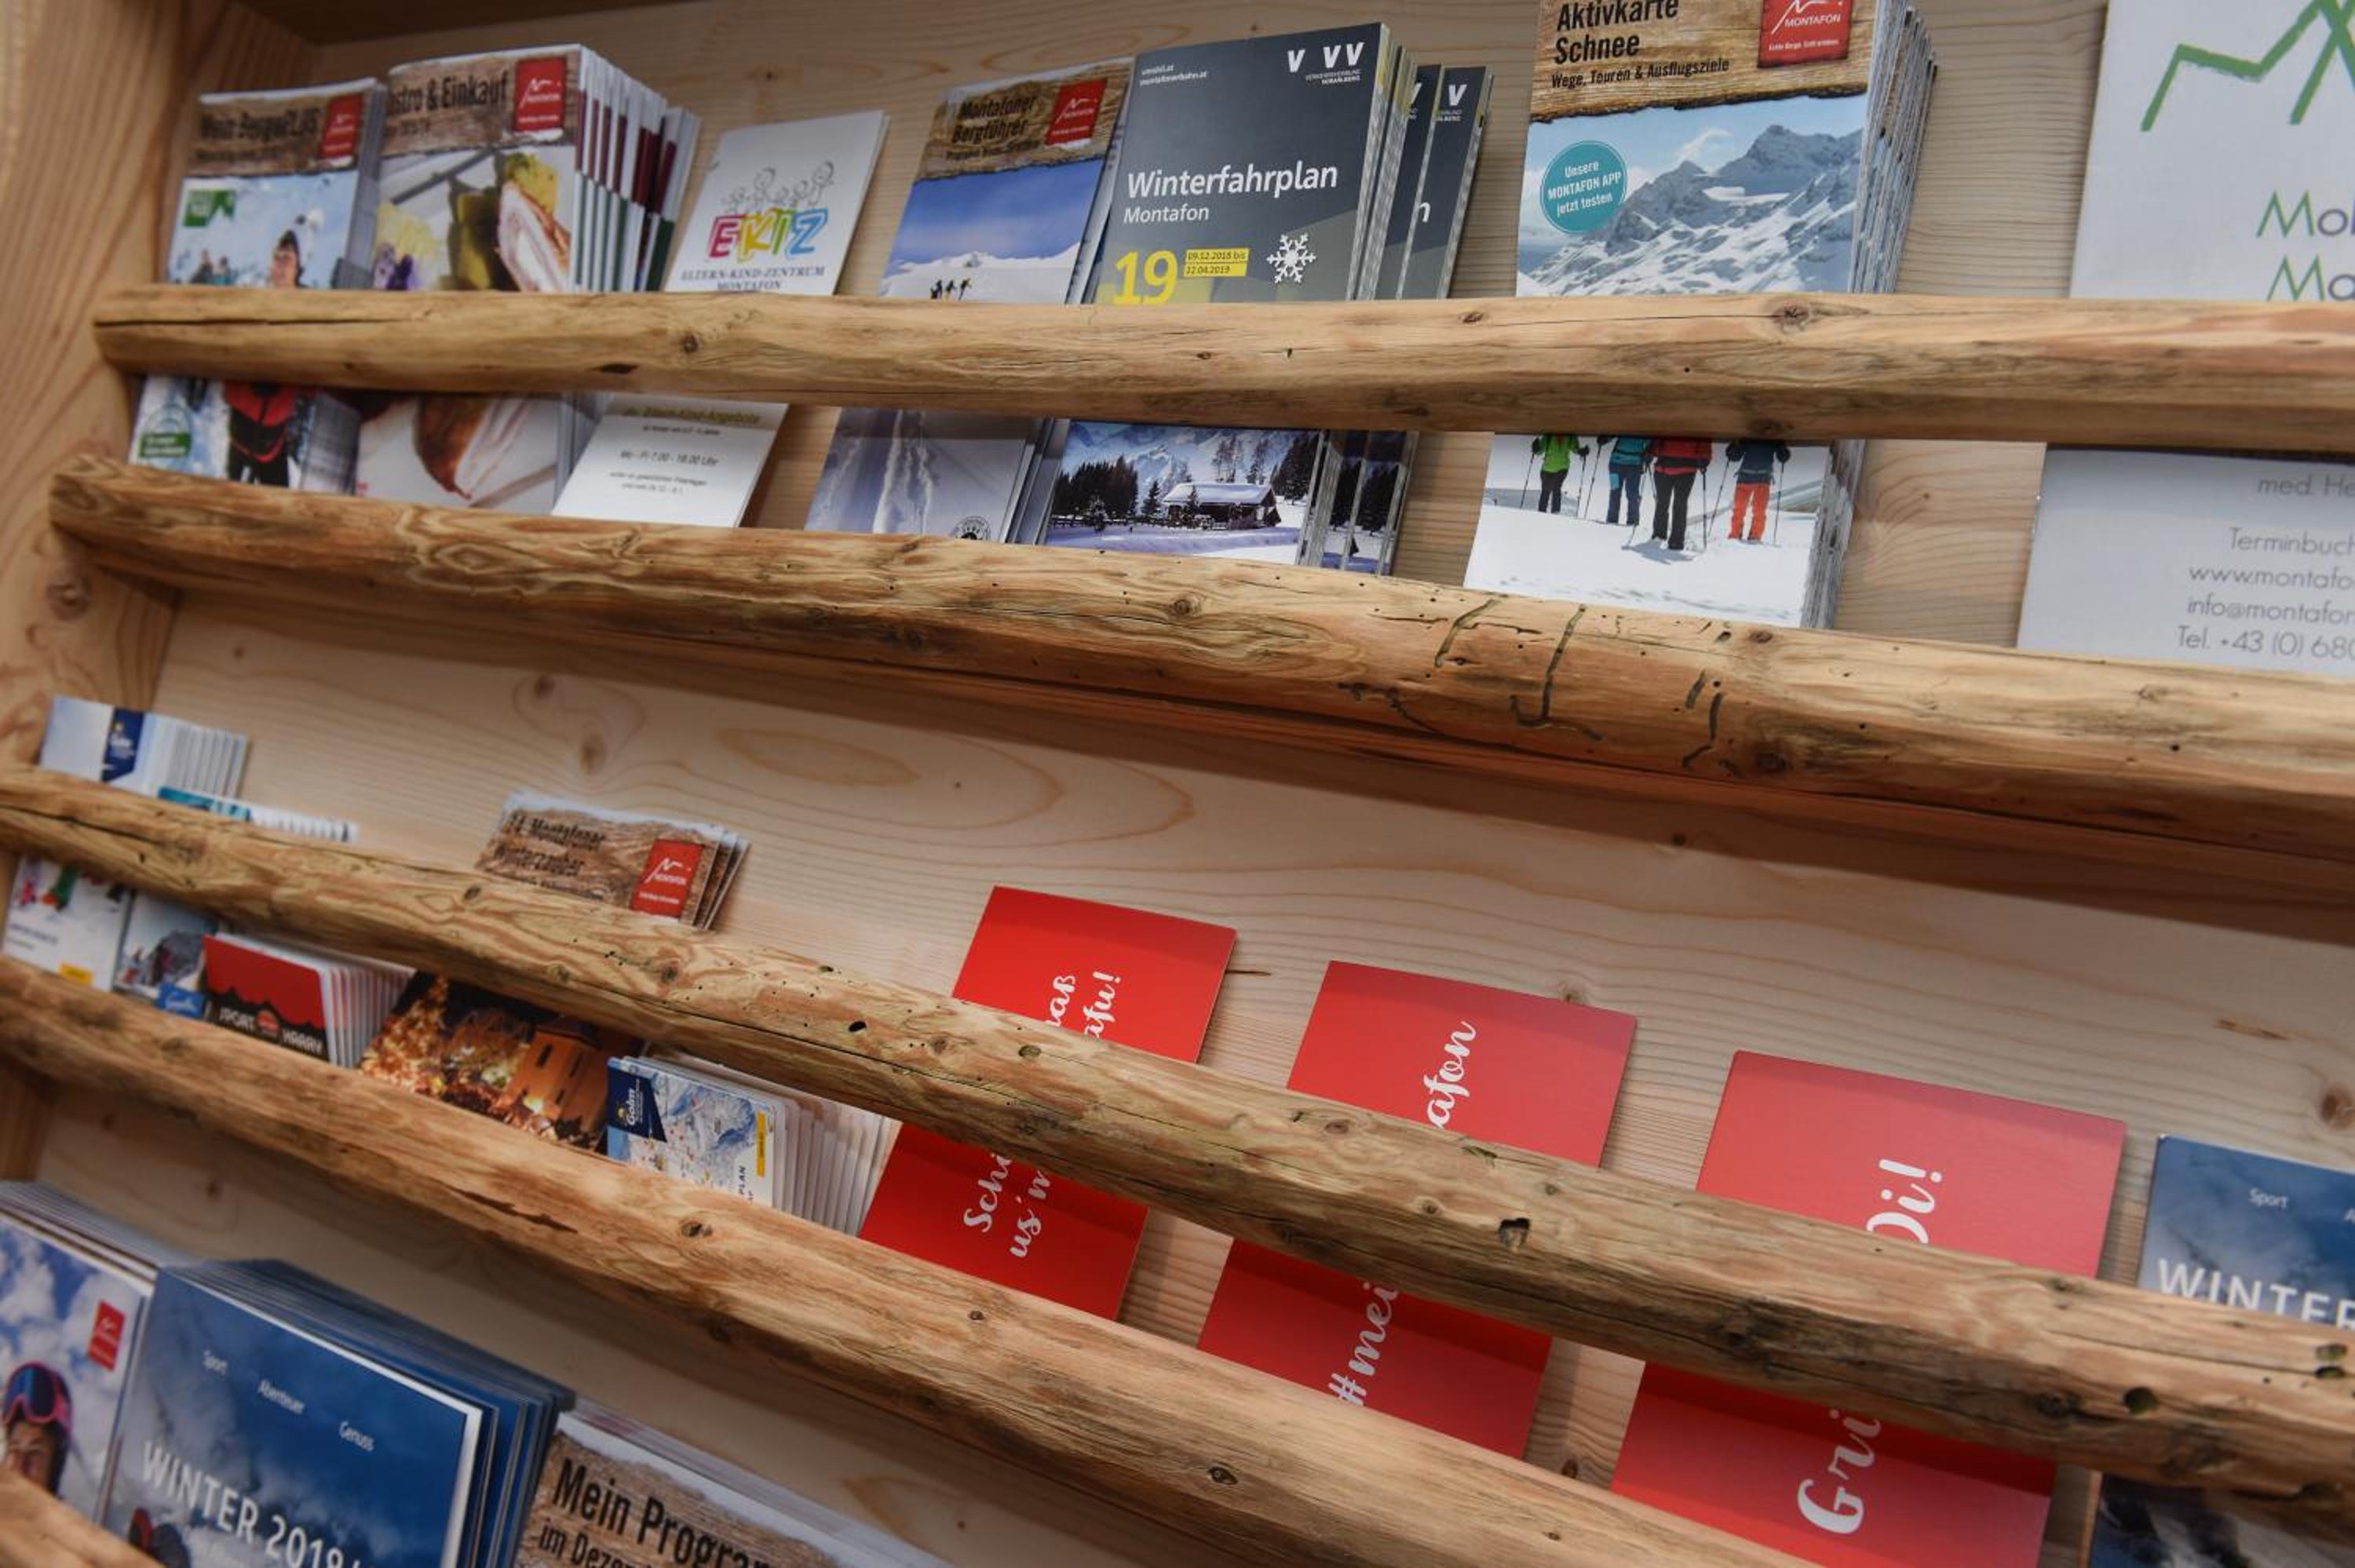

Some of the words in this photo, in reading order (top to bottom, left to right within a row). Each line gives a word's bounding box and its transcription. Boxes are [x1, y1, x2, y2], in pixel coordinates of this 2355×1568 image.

[1557, 0, 1679, 31] Aktivkarte
[1784, 13, 1841, 27] MONTAFON
[1554, 35, 1640, 64] Schnee
[1551, 74, 1586, 89] Wege,
[1590, 69, 1630, 84] Touren
[1634, 65, 1645, 79] &
[1648, 57, 1730, 78] Ausflugsziele
[442, 69, 509, 108] Einkauf
[958, 95, 1037, 119] Montafoner
[952, 119, 1029, 144] Bergführer
[1127, 160, 1338, 199] Winterfahrplan
[1565, 161, 1599, 178] Unsere
[1547, 177, 1600, 200] MONTAFON
[1602, 172, 1621, 188] APP
[1123, 202, 1210, 224] Montafon
[1557, 200, 1579, 217] jetzt
[1581, 192, 1613, 209] testen
[2255, 189, 2355, 238] Mo
[709, 207, 829, 263] EKIZ
[1233, 250, 1247, 260] bis
[1112, 250, 1178, 304] 19
[2258, 472, 2314, 496] med.
[2178, 625, 2211, 650] Tel.
[2220, 629, 2265, 653] +43
[2272, 630, 2304, 656] (0)
[2249, 1187, 2288, 1209] Sport
[141, 1439, 259, 1544] WINTER
[265, 1515, 363, 1568] 2018
[552, 1457, 631, 1535] Mein
[637, 1496, 772, 1568] Progra
[539, 1518, 567, 1558] im
